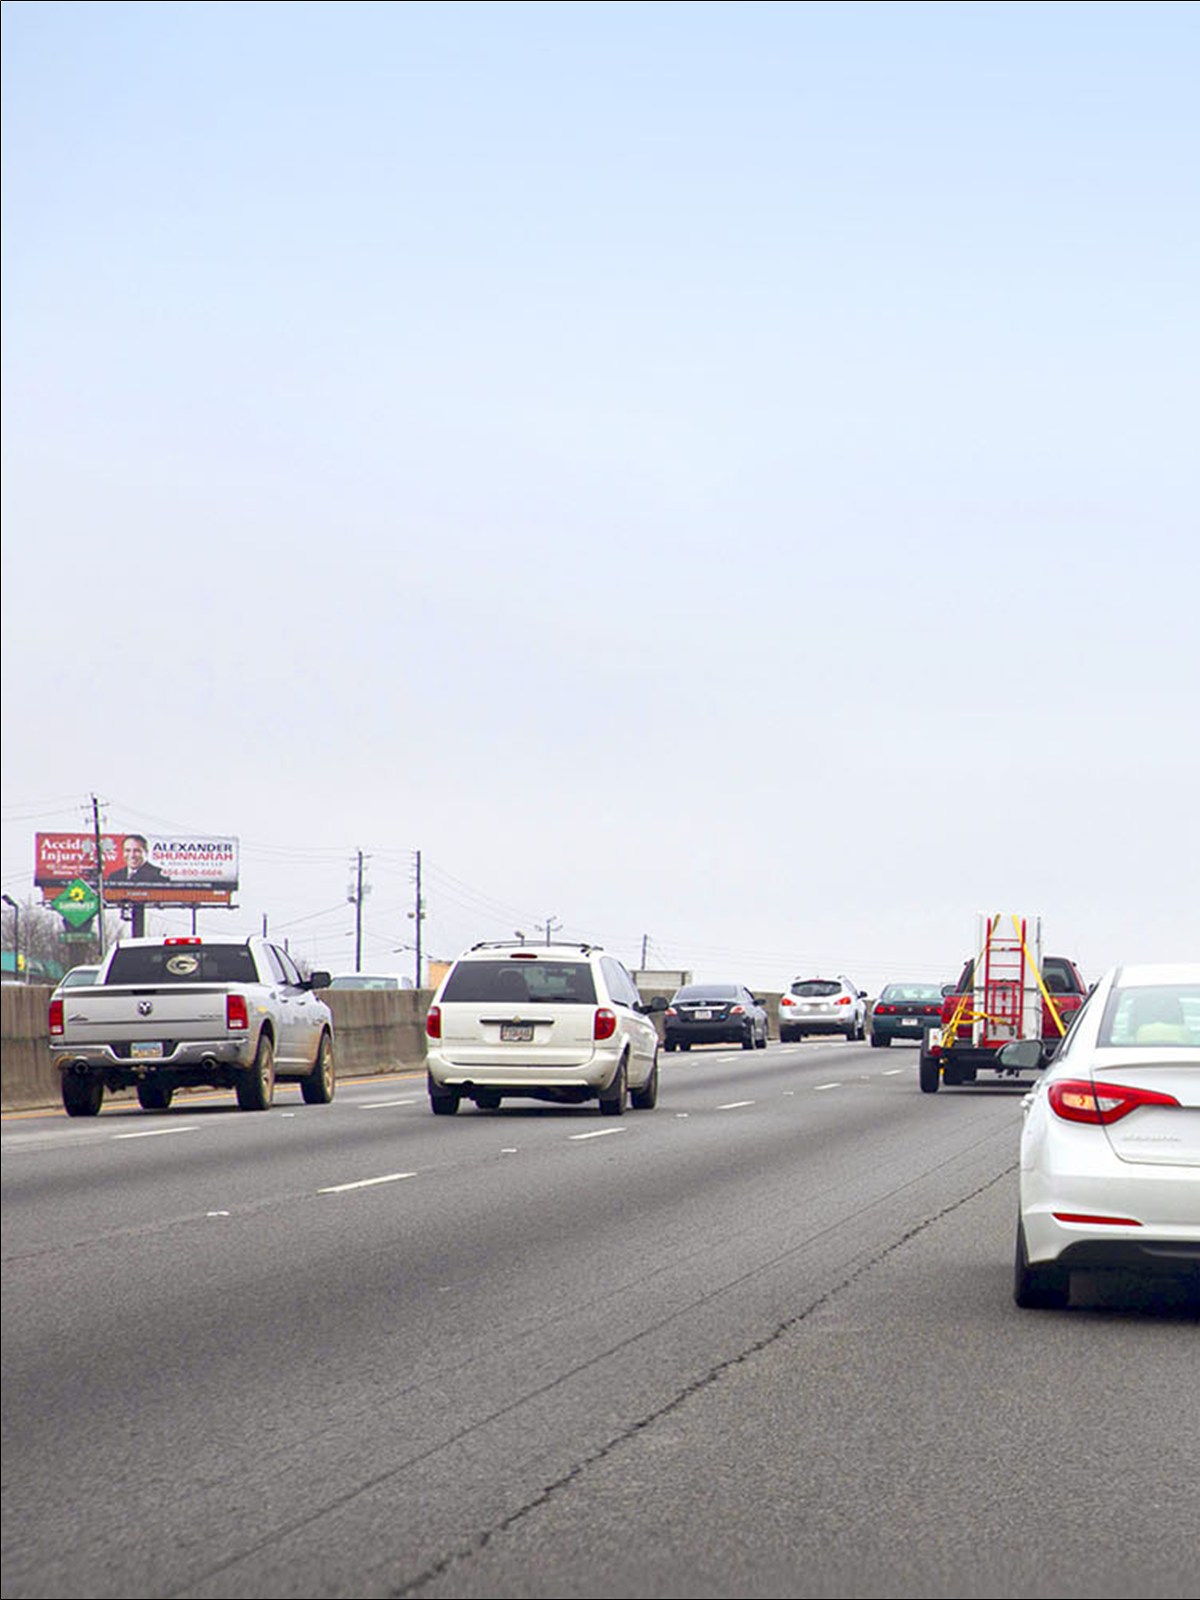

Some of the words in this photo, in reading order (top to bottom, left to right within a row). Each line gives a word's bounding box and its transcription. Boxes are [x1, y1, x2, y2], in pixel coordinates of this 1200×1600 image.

[153, 842, 232, 852] ALEXANDER
[41, 850, 84, 864] Injury
[152, 852, 233, 861] SHUNNARAH
